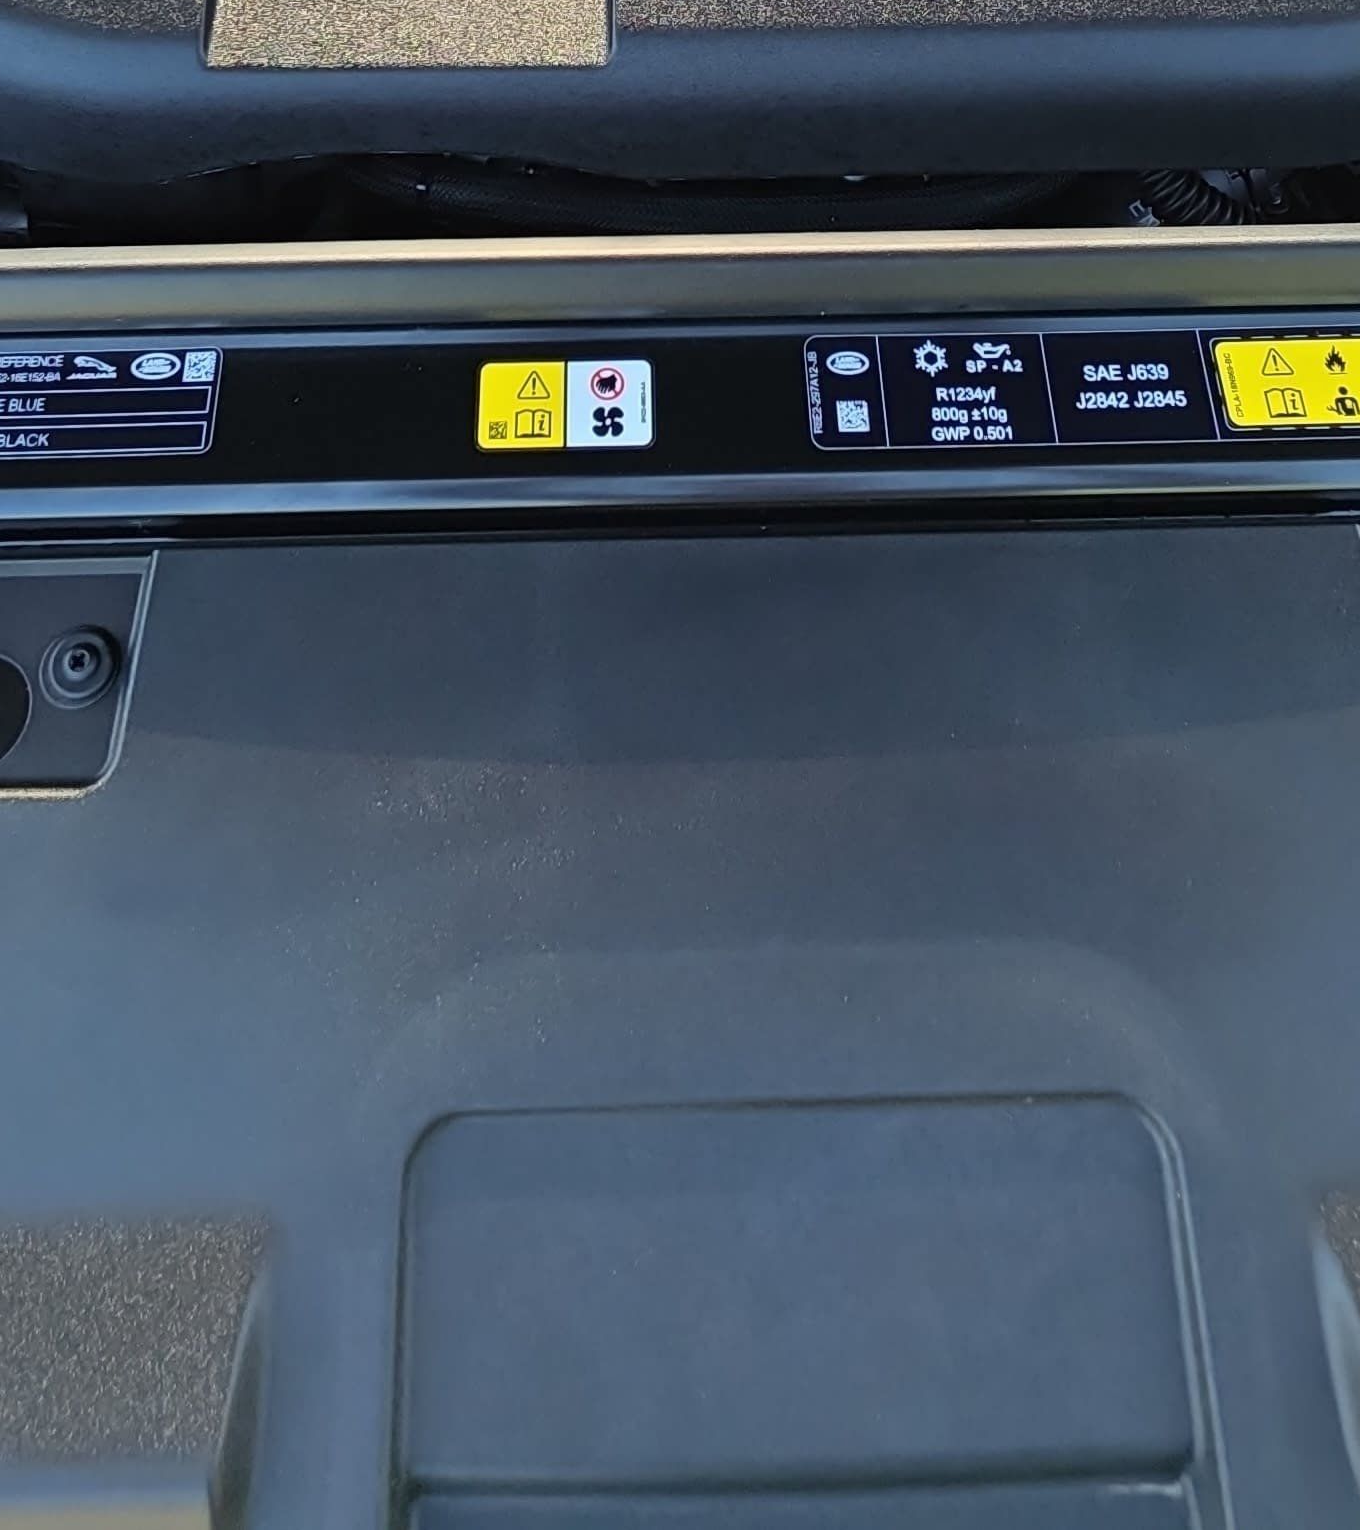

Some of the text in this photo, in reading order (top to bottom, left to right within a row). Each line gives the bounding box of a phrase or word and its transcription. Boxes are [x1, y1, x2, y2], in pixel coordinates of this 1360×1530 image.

[965, 360, 987, 373] SP
[1002, 359, 1024, 372] A2
[1083, 363, 1169, 381] SAE J639
[935, 386, 997, 402] R1234yf
[1075, 389, 1188, 410] J2842 J2845
[7, 397, 46, 412] BLUE
[931, 406, 1008, 423] 800g ±10g
[931, 426, 1014, 441] GWP 0.501
